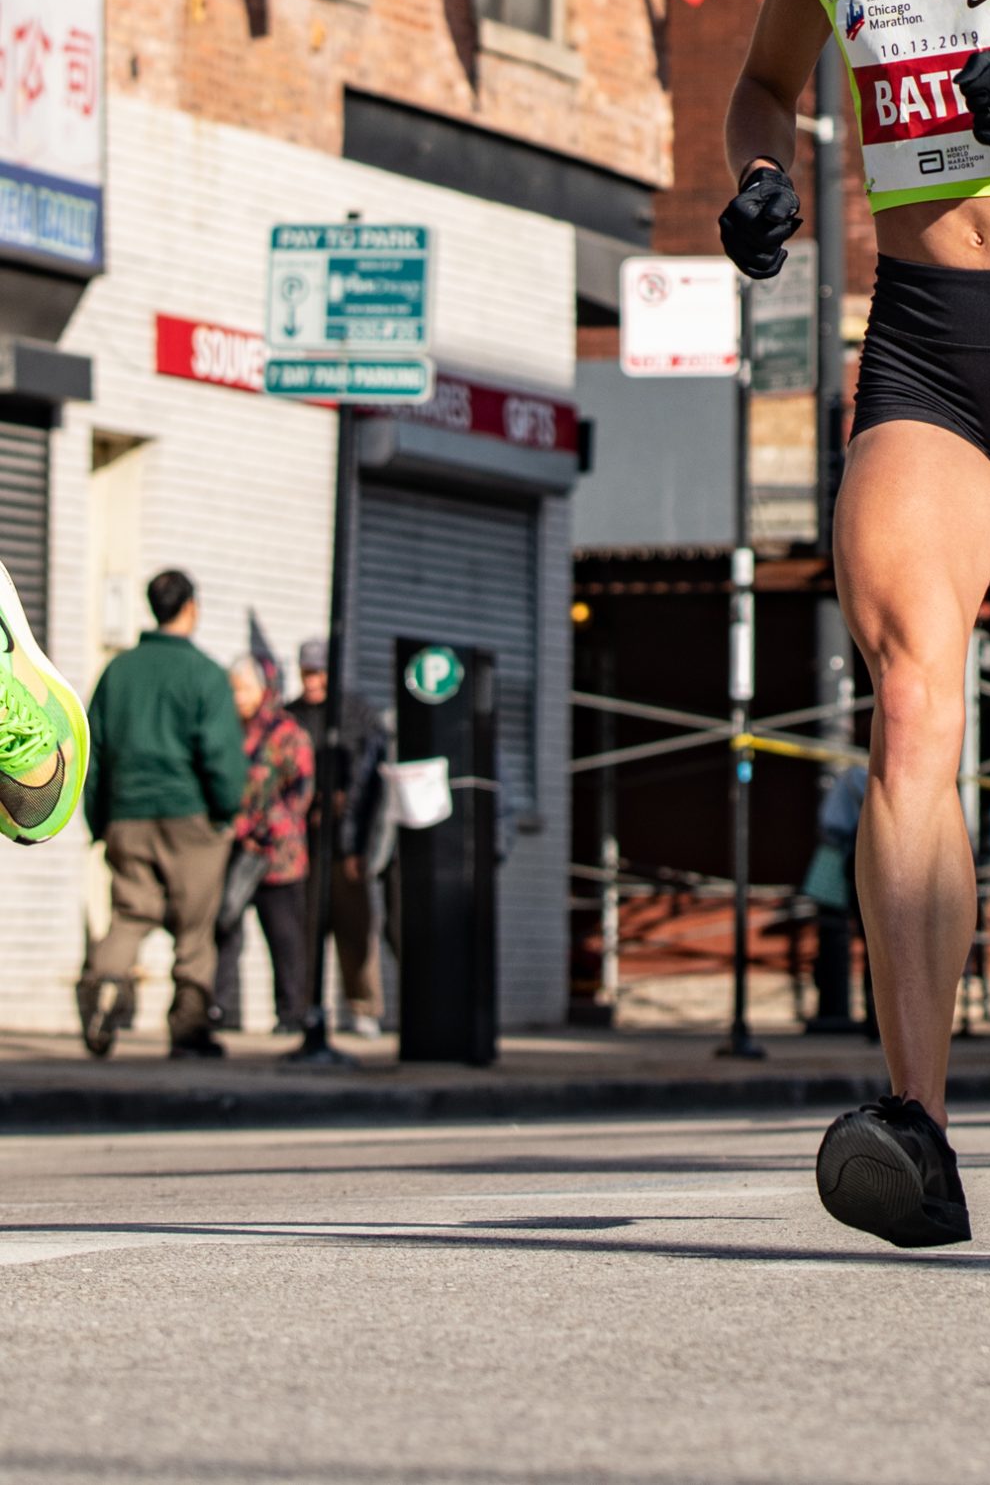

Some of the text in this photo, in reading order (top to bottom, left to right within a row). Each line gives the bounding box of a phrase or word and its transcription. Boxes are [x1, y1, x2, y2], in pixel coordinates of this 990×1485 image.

[867, 3, 911, 17] Chicago
[869, 14, 923, 31] Marathon
[881, 30, 979, 58] 10.13.2019
[946, 144, 969, 154] ABBOTT
[947, 151, 969, 159] WORLD
[947, 155, 985, 165] MARATHON
[948, 162, 975, 171] MAJORS
[277, 228, 420, 249] PAY TO PARK
[190, 324, 265, 391] SOUVE
[352, 366, 423, 390] PARKING
